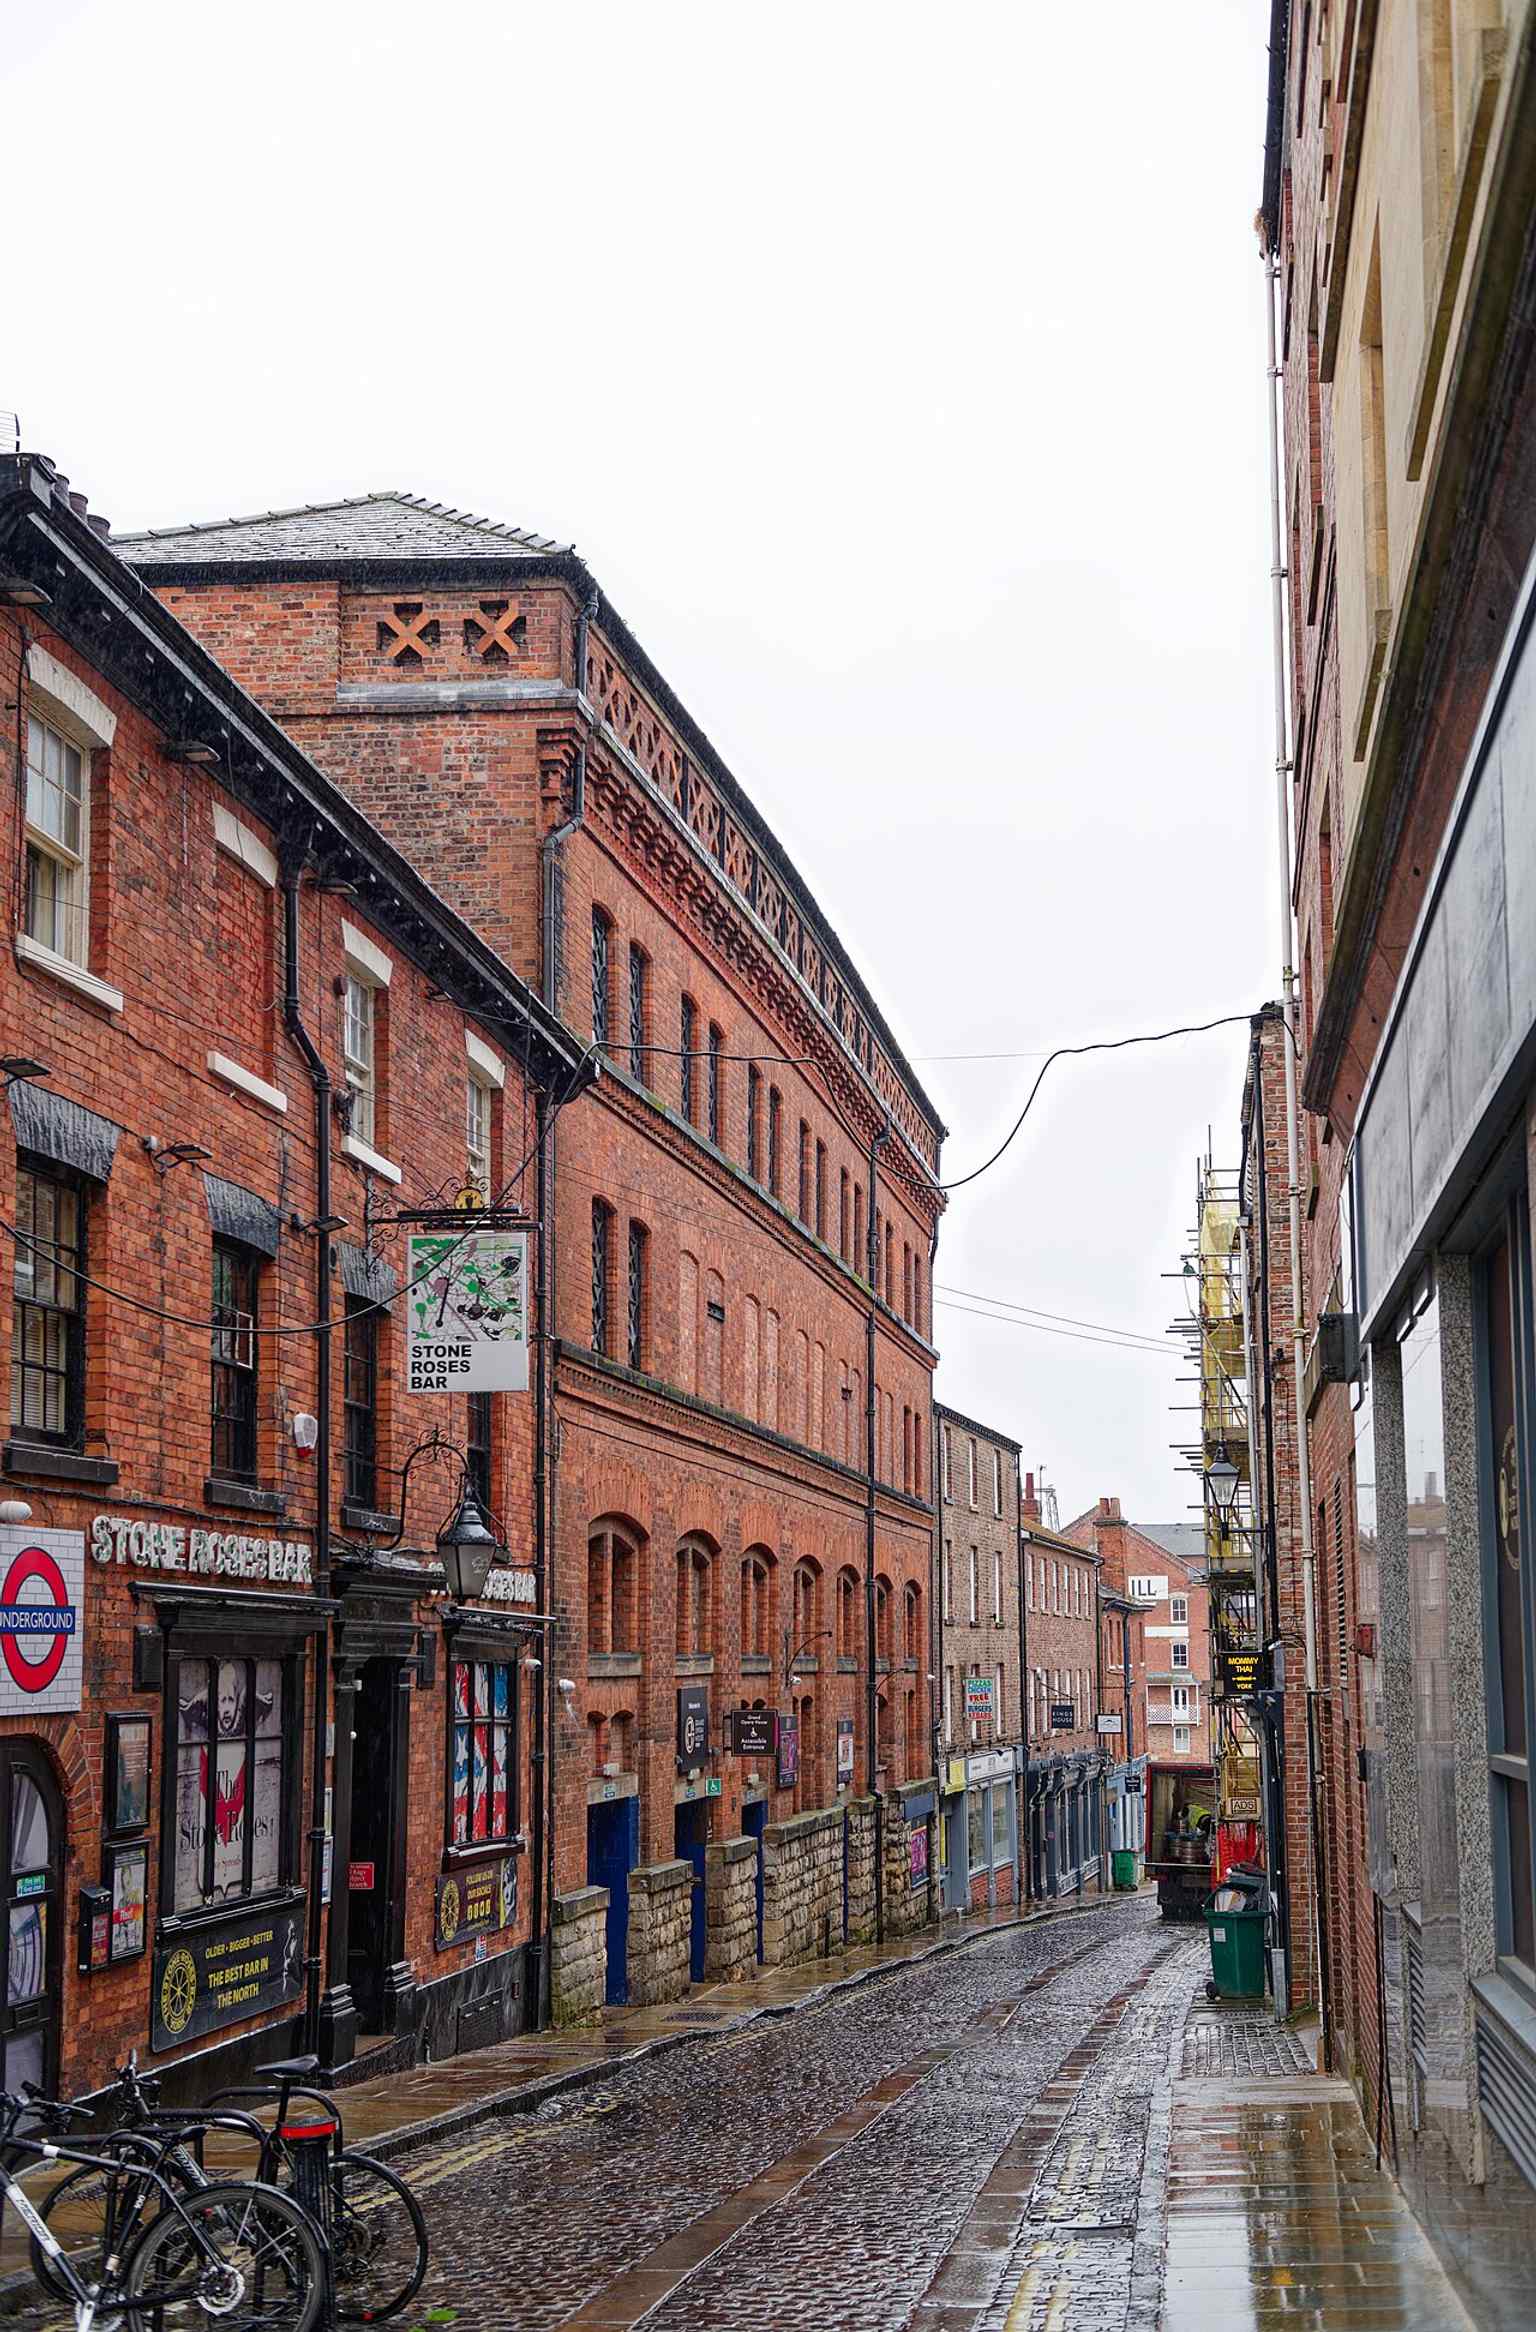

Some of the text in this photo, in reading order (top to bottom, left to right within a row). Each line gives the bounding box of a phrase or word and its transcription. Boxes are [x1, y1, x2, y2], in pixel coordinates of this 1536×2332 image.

[411, 1344, 472, 1358] STONE
[411, 1360, 471, 1374] ROSES
[411, 1376, 448, 1389] BAR
[91, 1515, 313, 1584] STONE ROSES BAR
[514, 1571, 537, 1604] BAR
[0, 1611, 74, 1629] NDERGROUND
[1227, 1656, 1259, 1665] MOMMY
[1235, 1665, 1253, 1673] THAI
[968, 1693, 990, 1702] FREE
[1233, 1800, 1255, 1811] ADS
[205, 1930, 273, 1959] OLDER BIGGER BETTER
[208, 1956, 269, 1989] THE BEST BAR IN
[217, 1982, 259, 2009] THE NORTH
